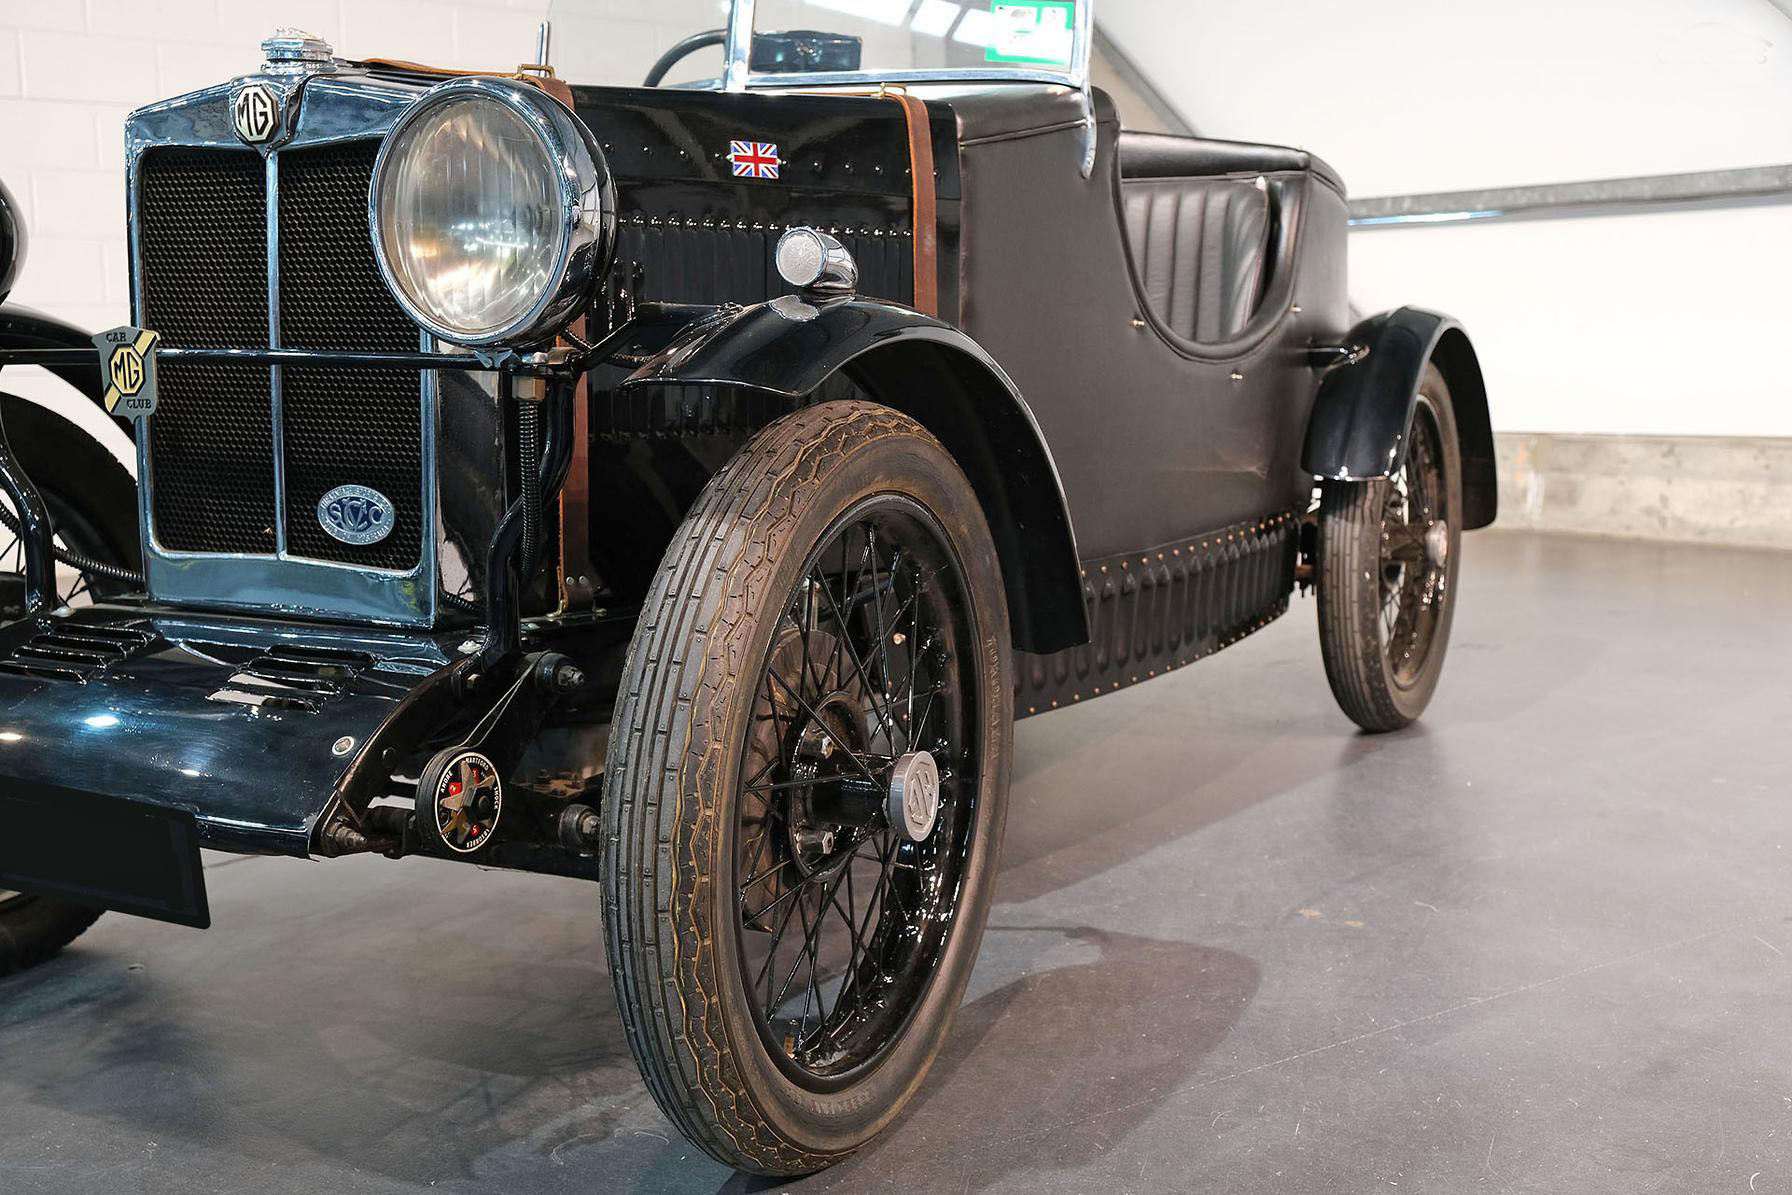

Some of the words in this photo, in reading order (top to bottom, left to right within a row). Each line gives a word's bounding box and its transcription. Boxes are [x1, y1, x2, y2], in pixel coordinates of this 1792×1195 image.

[237, 92, 269, 137] MG
[106, 331, 127, 343] CAR
[113, 351, 141, 390] MG
[126, 398, 152, 409] CLUB
